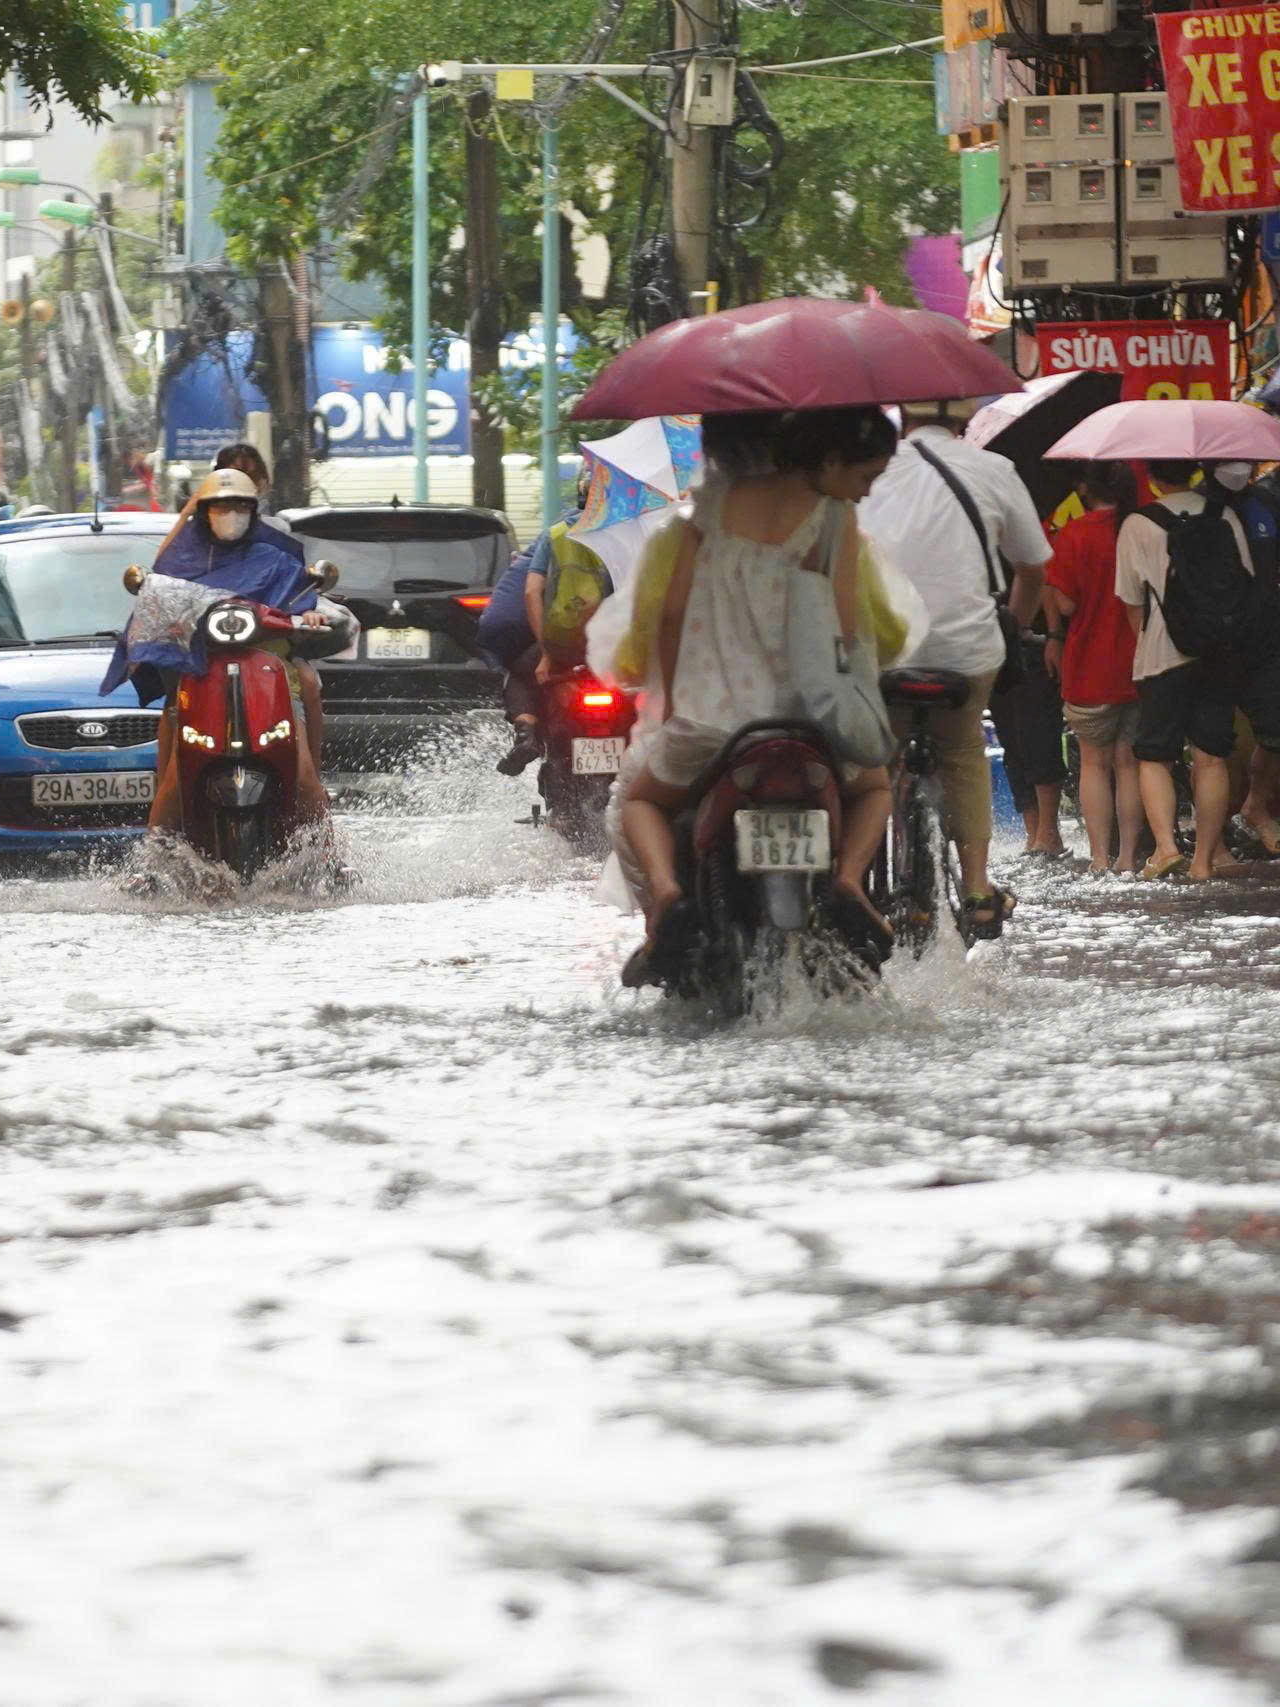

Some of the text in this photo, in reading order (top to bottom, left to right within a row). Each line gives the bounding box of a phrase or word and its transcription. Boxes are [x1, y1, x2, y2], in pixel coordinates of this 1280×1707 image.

[1182, 52, 1248, 108] XE
[1193, 135, 1258, 199] XE
[1051, 328, 1215, 369] SỬA CHỮA
[81, 725, 105, 734] KIA
[36, 776, 152, 801] 29A-384.55
